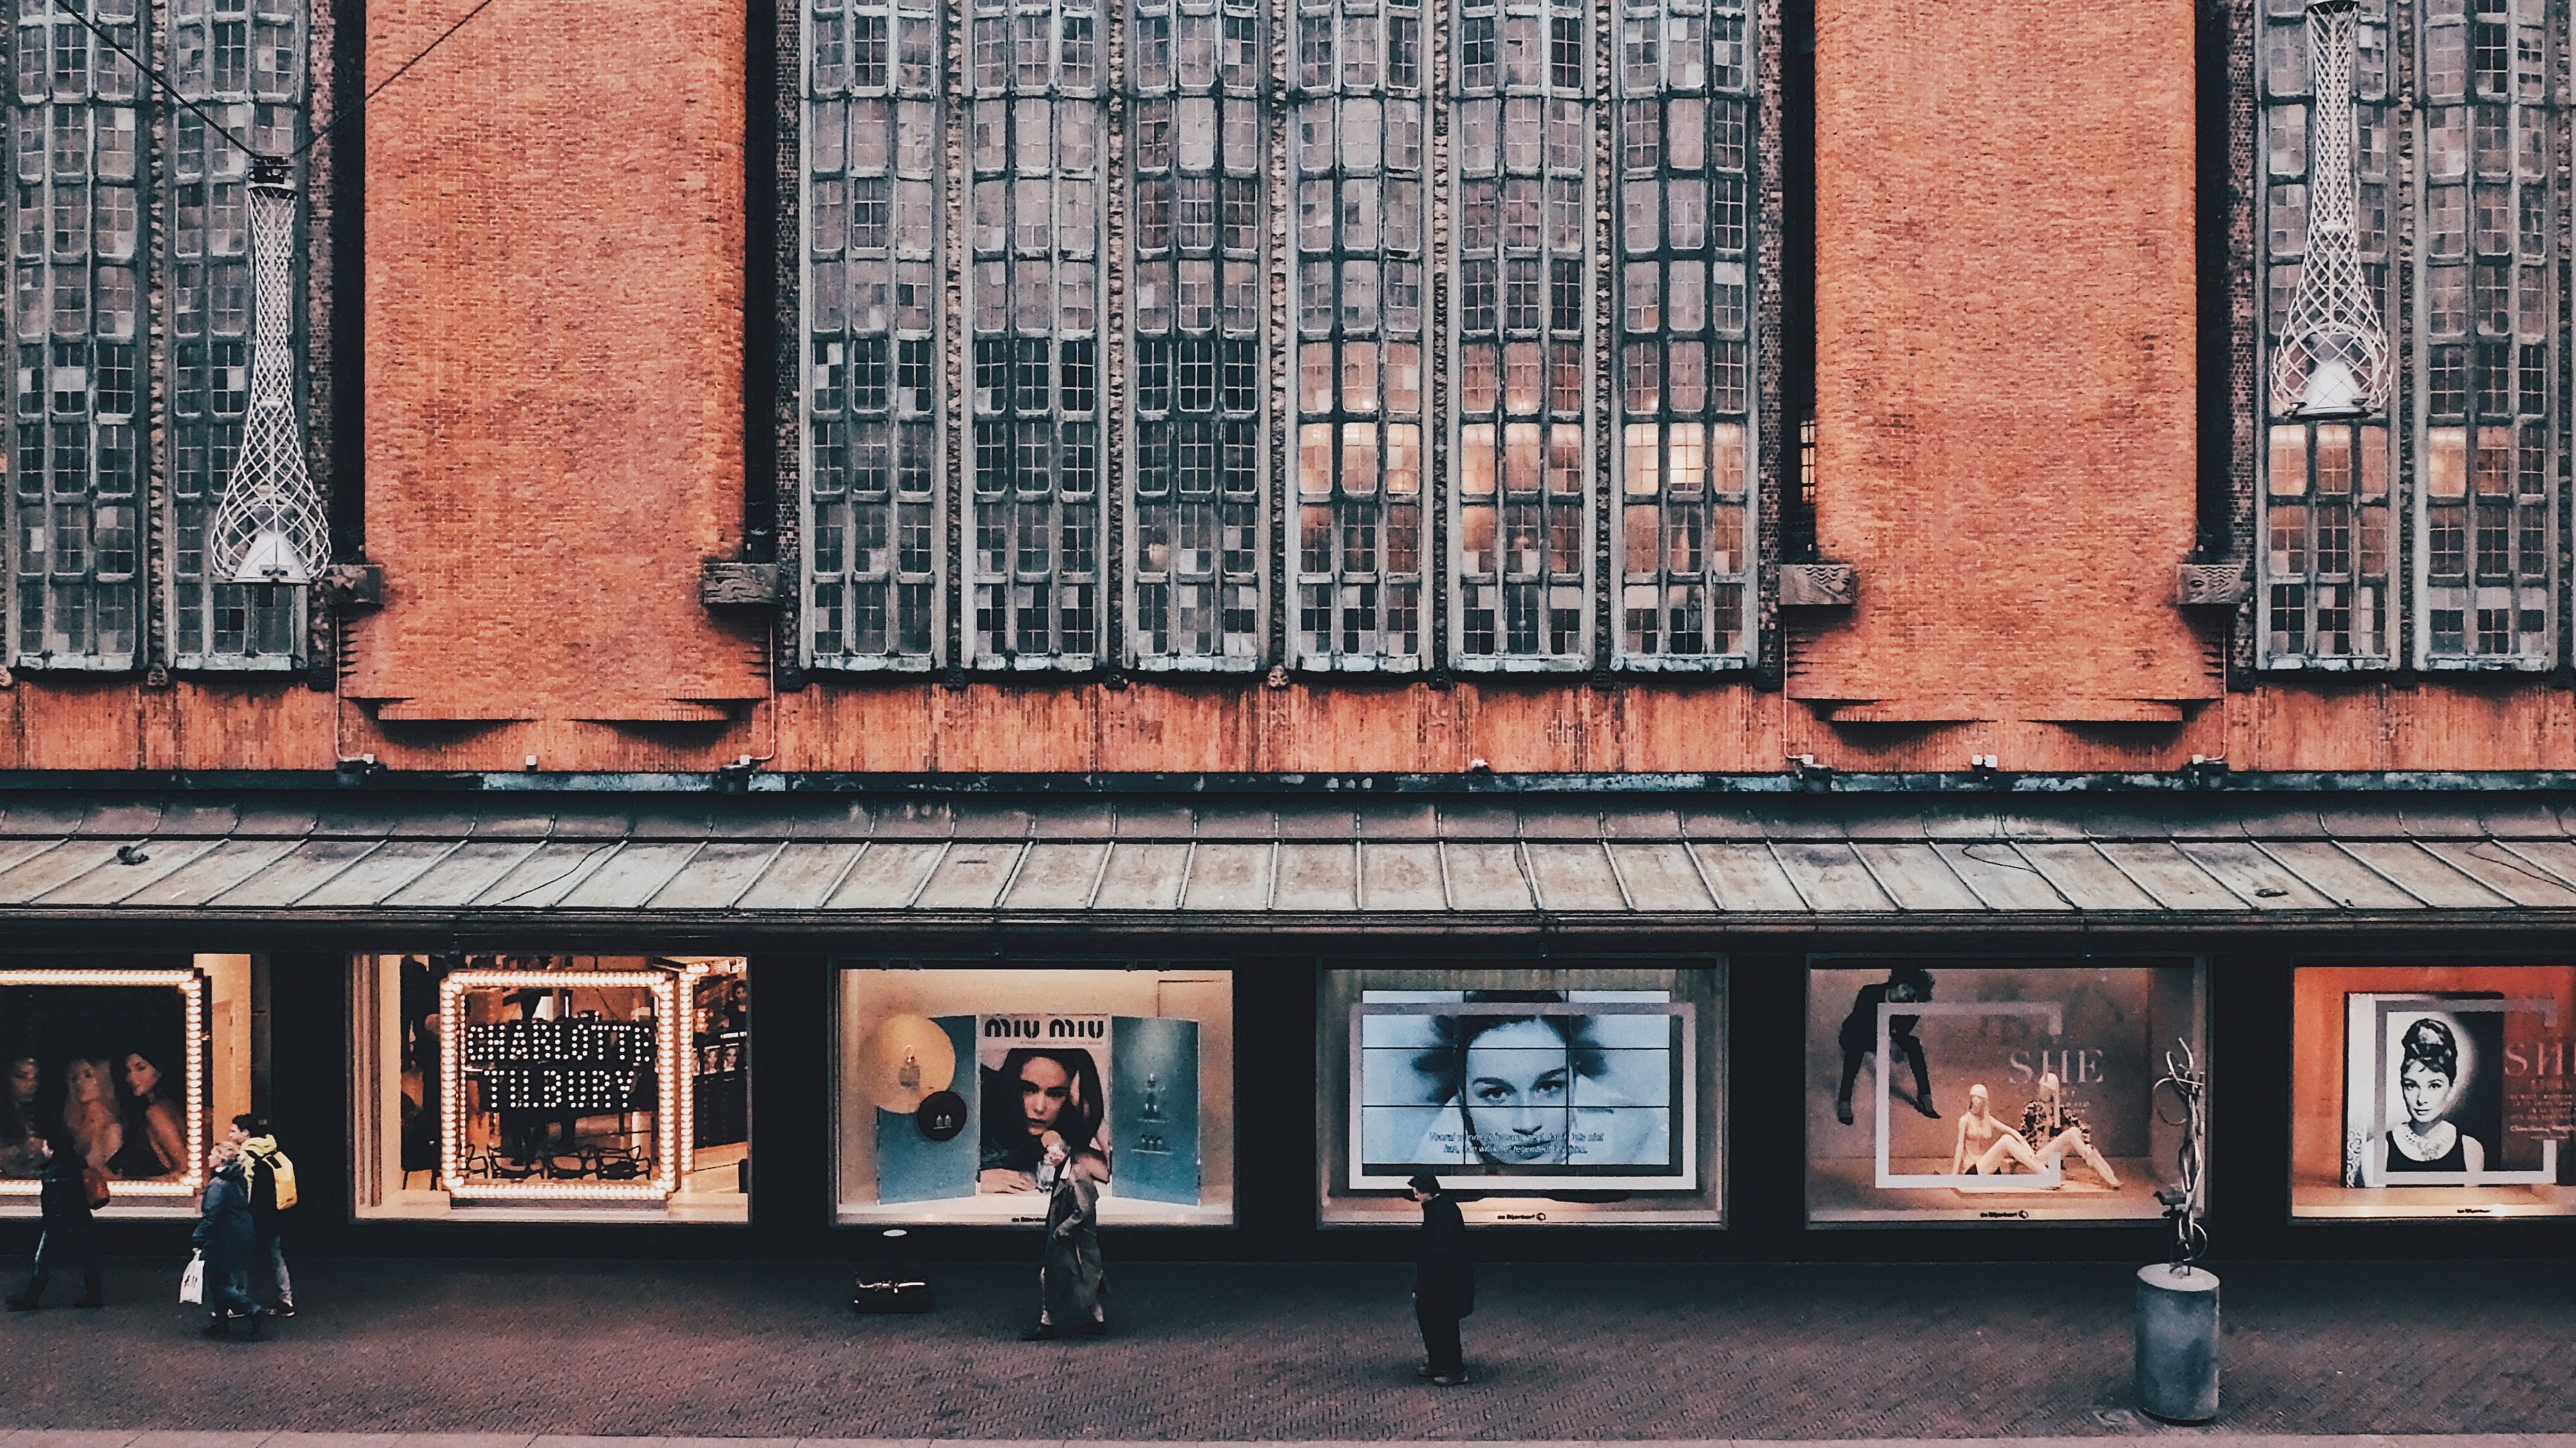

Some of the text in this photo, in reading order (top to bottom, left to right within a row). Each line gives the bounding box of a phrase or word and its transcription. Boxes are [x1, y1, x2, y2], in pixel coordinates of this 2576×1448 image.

[468, 1024, 650, 1062] CHARLOTTE
[985, 1018, 1104, 1038] MIU MIU
[2009, 1049, 2103, 1083] SHE
[2505, 1042, 2576, 1076] SH
[484, 1069, 634, 1108] TILBURY
